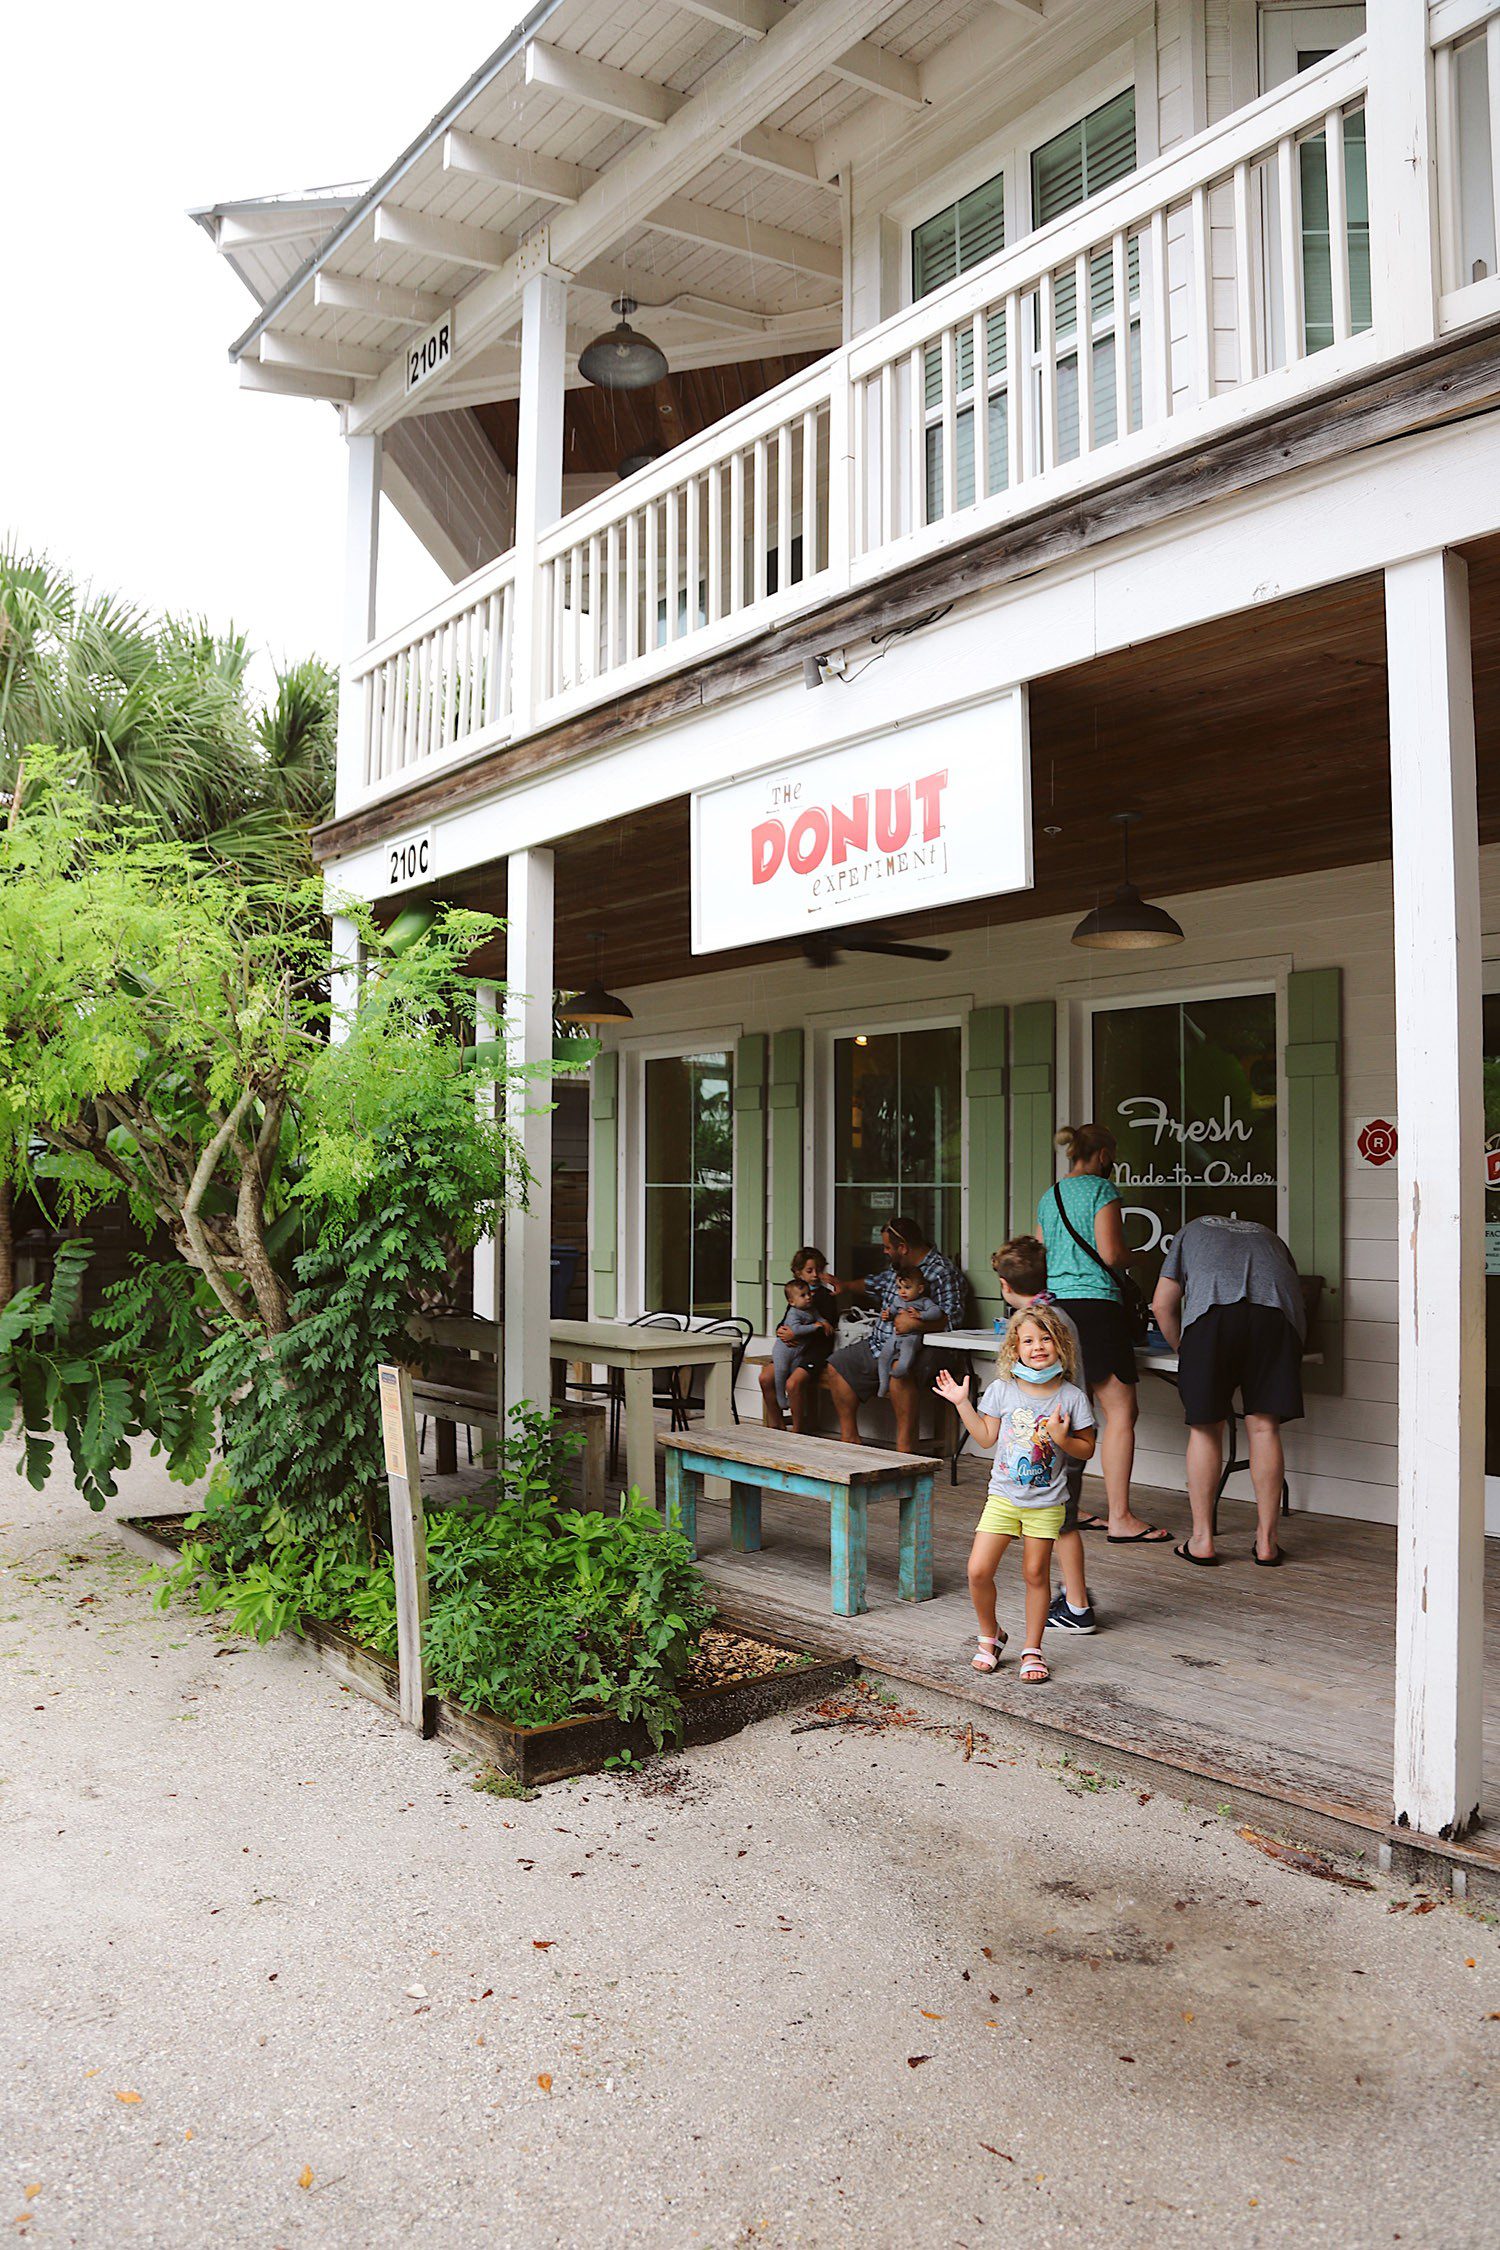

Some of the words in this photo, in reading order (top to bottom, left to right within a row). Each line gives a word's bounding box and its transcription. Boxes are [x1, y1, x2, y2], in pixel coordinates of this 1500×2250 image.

[410, 324, 449, 385] 210R
[751, 768, 948, 885] DONUT
[390, 839, 429, 885] 210C
[1117, 1095, 1253, 1146] Fresh
[1373, 1137, 1384, 1148] R
[1018, 1463, 1043, 1477] Anna
